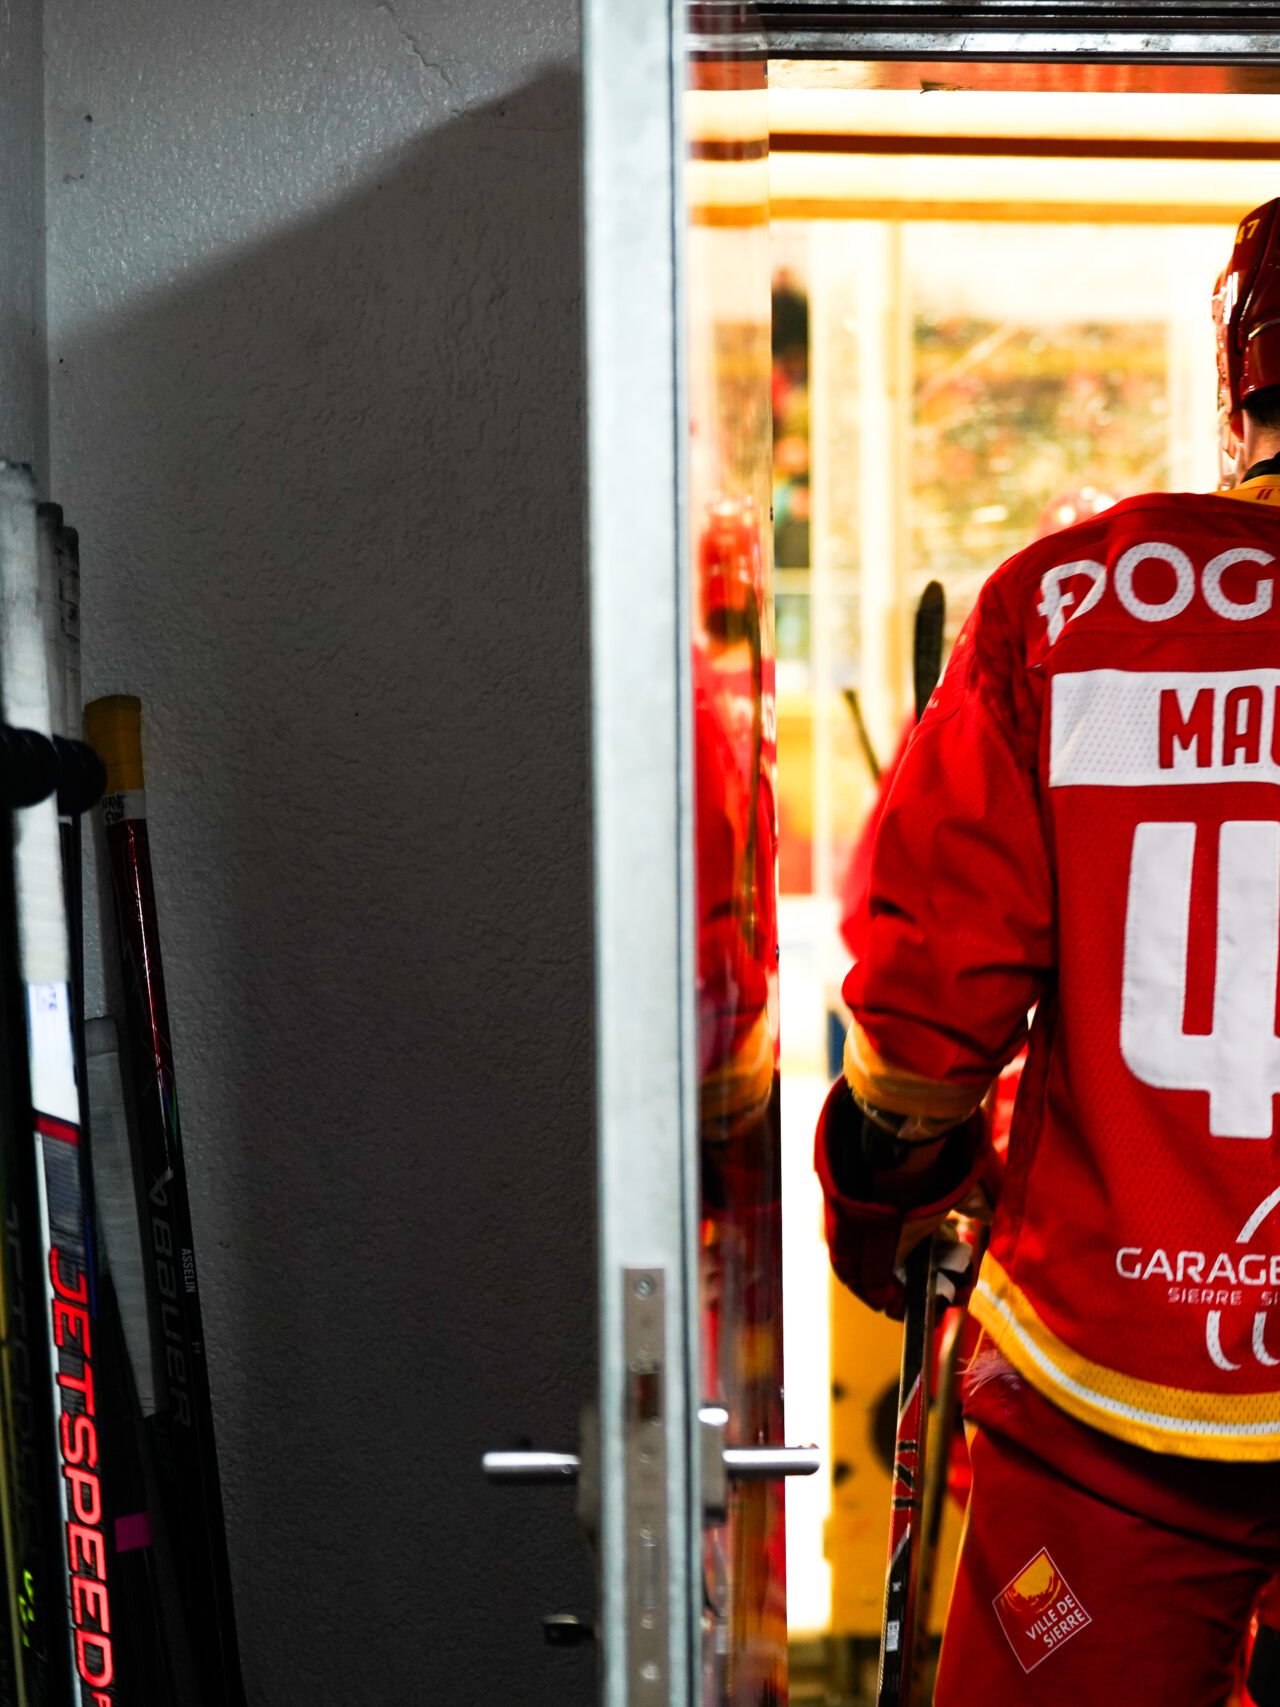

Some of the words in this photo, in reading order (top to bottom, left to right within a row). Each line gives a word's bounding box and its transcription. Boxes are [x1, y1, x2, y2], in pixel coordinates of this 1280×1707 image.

[181, 1248, 196, 1294] ASSELIN
[1167, 1286, 1243, 1307] SIERRE
[49, 1246, 114, 1689] JETSPEED
[1025, 1609, 1059, 1641] VILLE
[1056, 1595, 1076, 1614] DE
[1043, 1608, 1086, 1649] SIERRE
